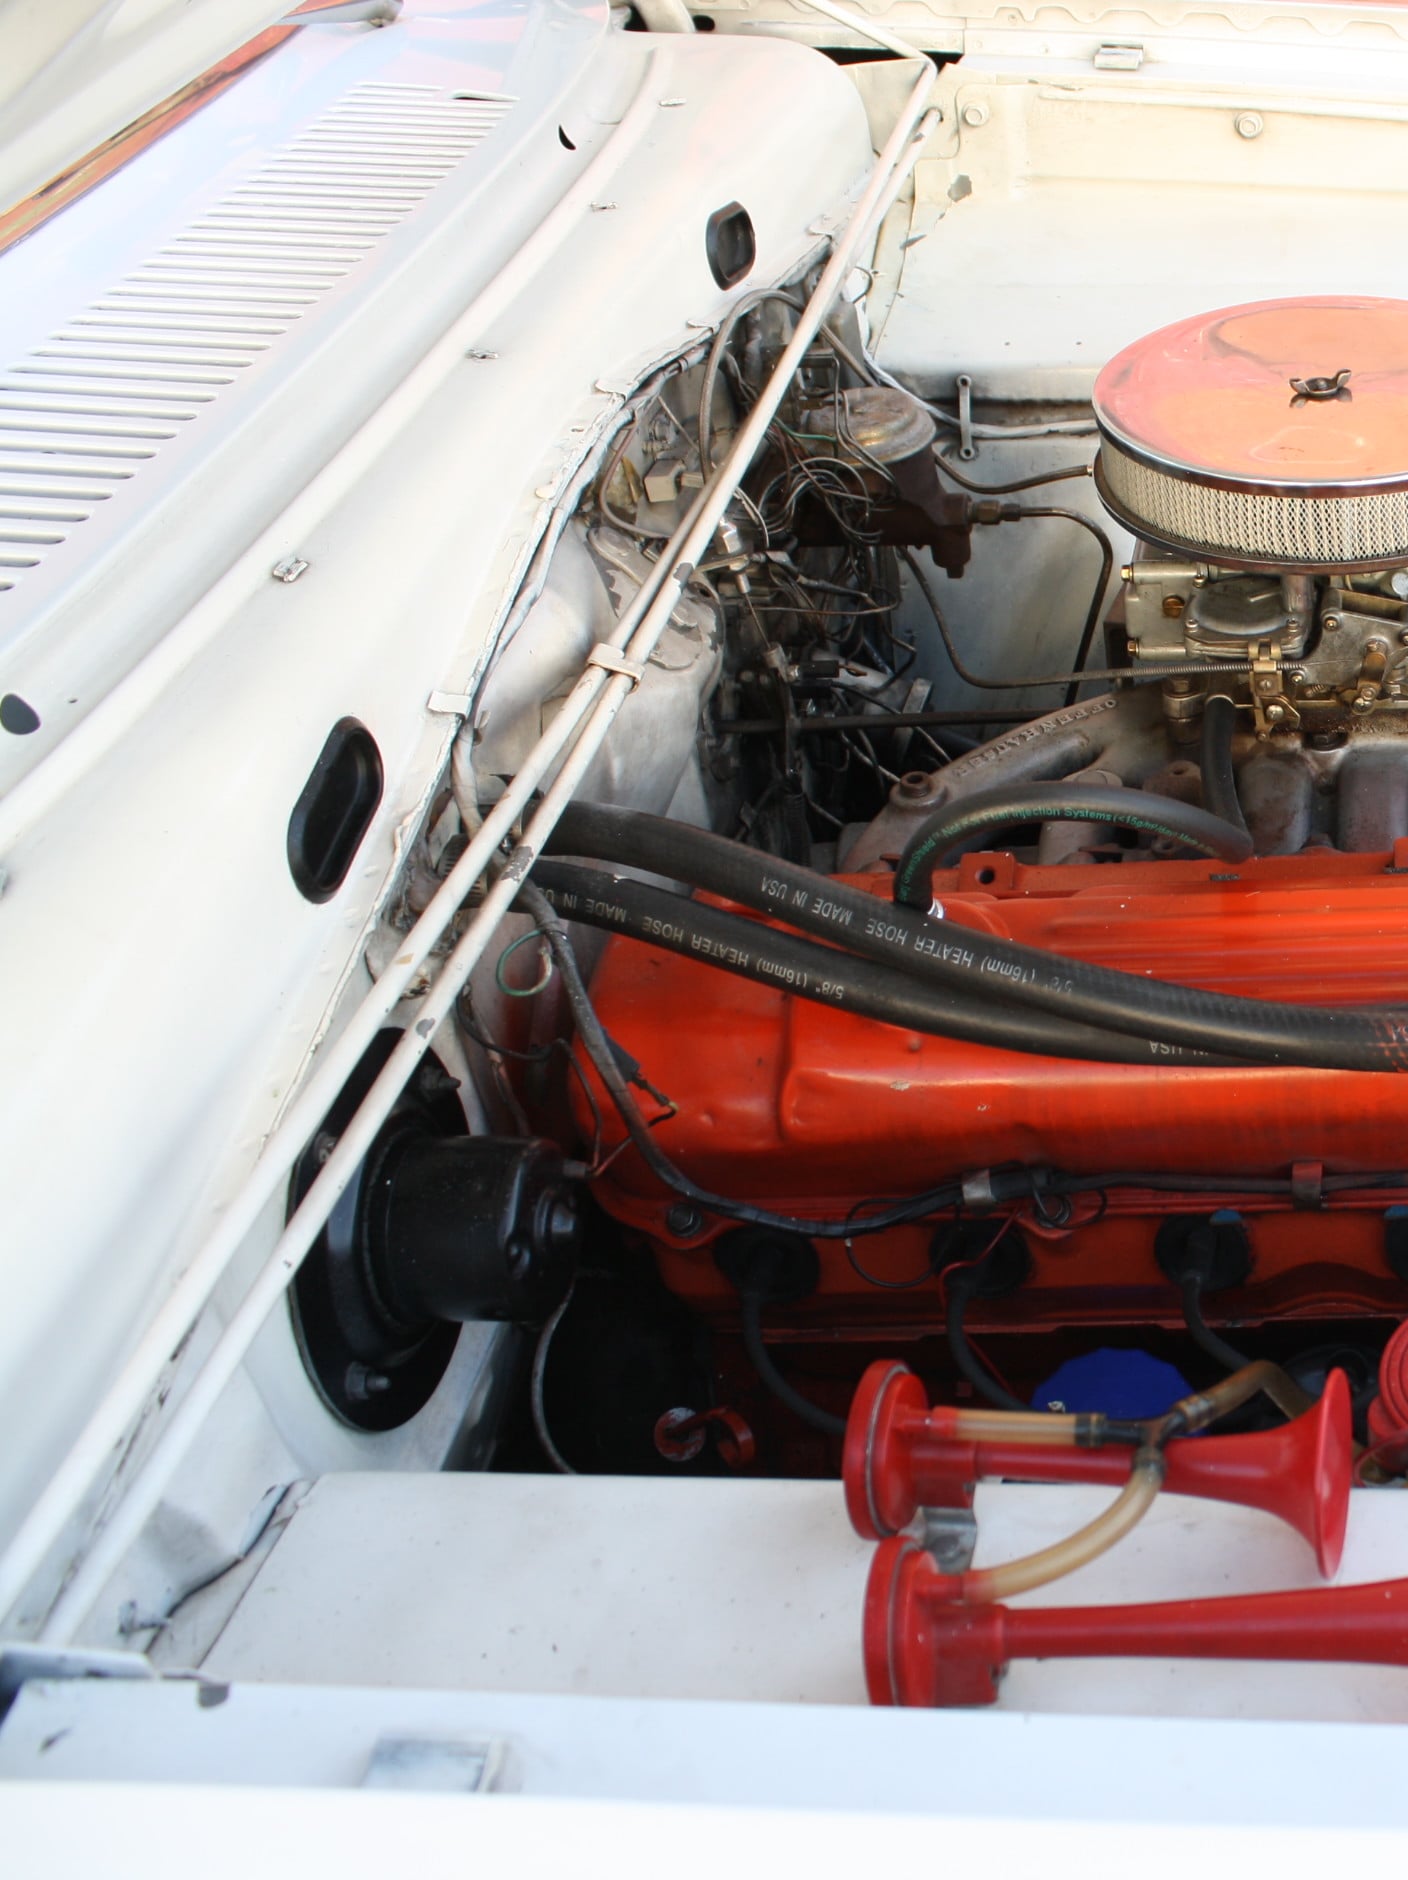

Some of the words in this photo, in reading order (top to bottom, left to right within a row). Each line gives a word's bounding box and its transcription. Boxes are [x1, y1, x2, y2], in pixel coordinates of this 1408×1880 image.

[954, 698, 1117, 777] OFFENHAUSER
[941, 822, 962, 838] Not
[1011, 806, 1061, 820] Injection
[1064, 806, 1112, 822] Systems
[562, 893, 577, 909] IN
[760, 876, 788, 899] USA
[792, 889, 809, 906] IN
[585, 898, 627, 923] MADE
[811, 897, 853, 926] MADE
[642, 915, 684, 943] HOSE
[864, 917, 909, 945] HOSE
[691, 934, 750, 968] HEATER
[913, 934, 975, 968] HEATER
[756, 957, 809, 988] (16mm)
[980, 956, 1036, 983] (16mm)
[815, 980, 845, 1000] 5/8"
